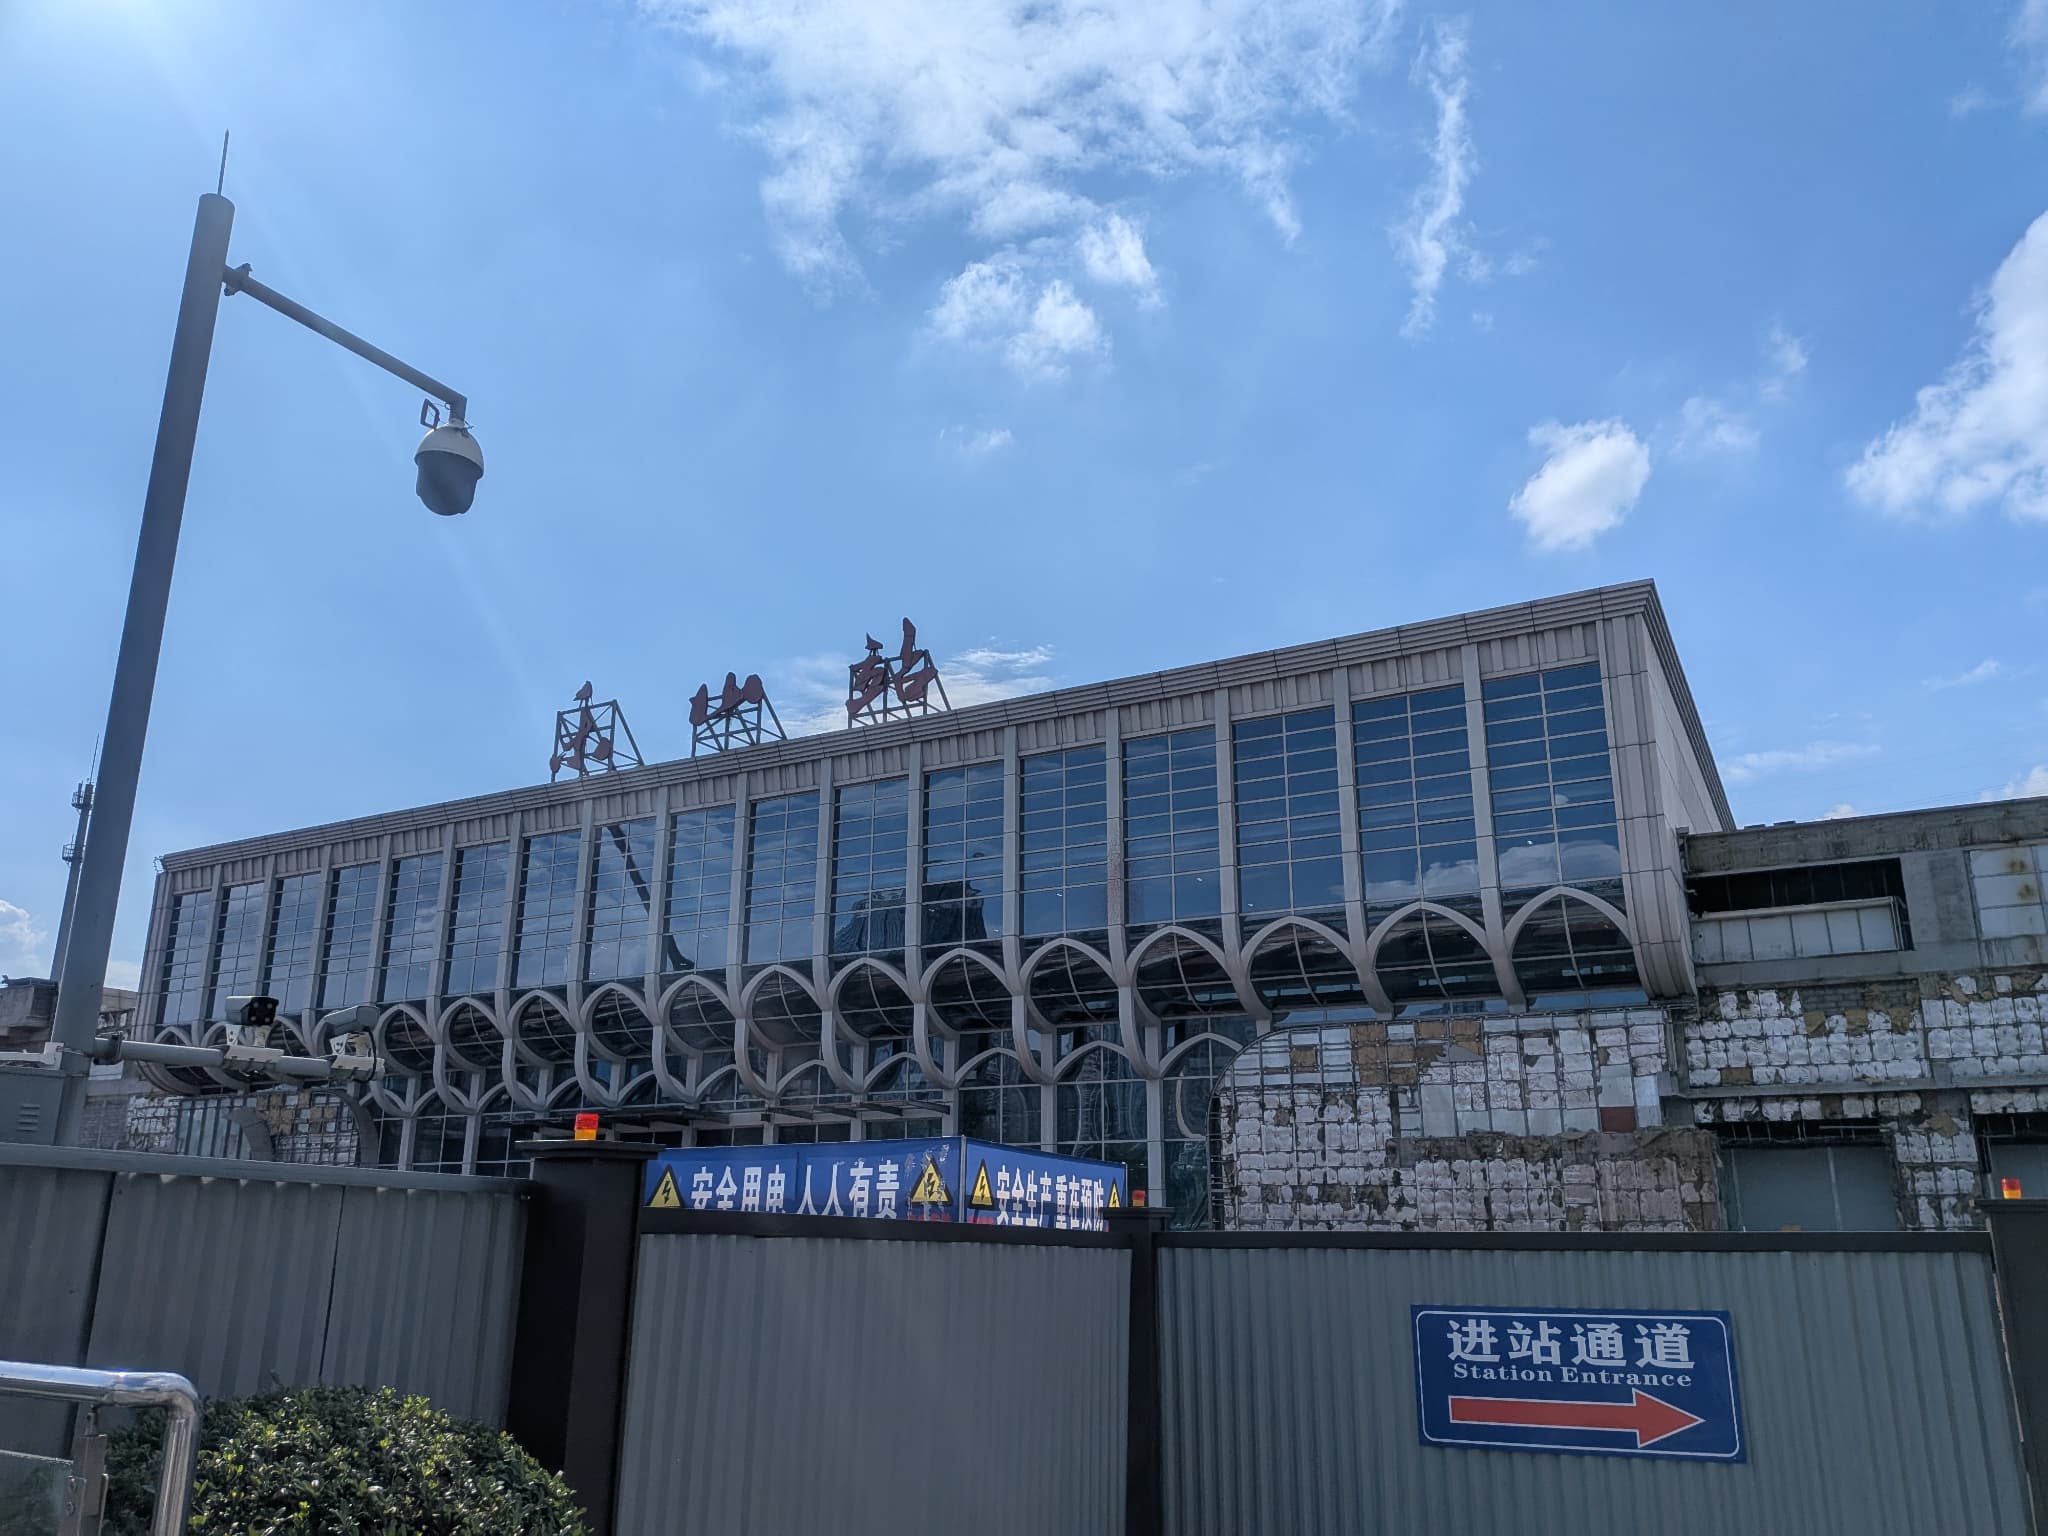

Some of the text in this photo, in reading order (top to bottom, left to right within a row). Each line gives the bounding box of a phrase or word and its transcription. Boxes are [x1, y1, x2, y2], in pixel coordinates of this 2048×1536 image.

[996, 1164, 1104, 1232] 安全生产重在预防
[1446, 1318, 1696, 1369] 进站通道
[1453, 1363, 1693, 1388] Station Entrance
